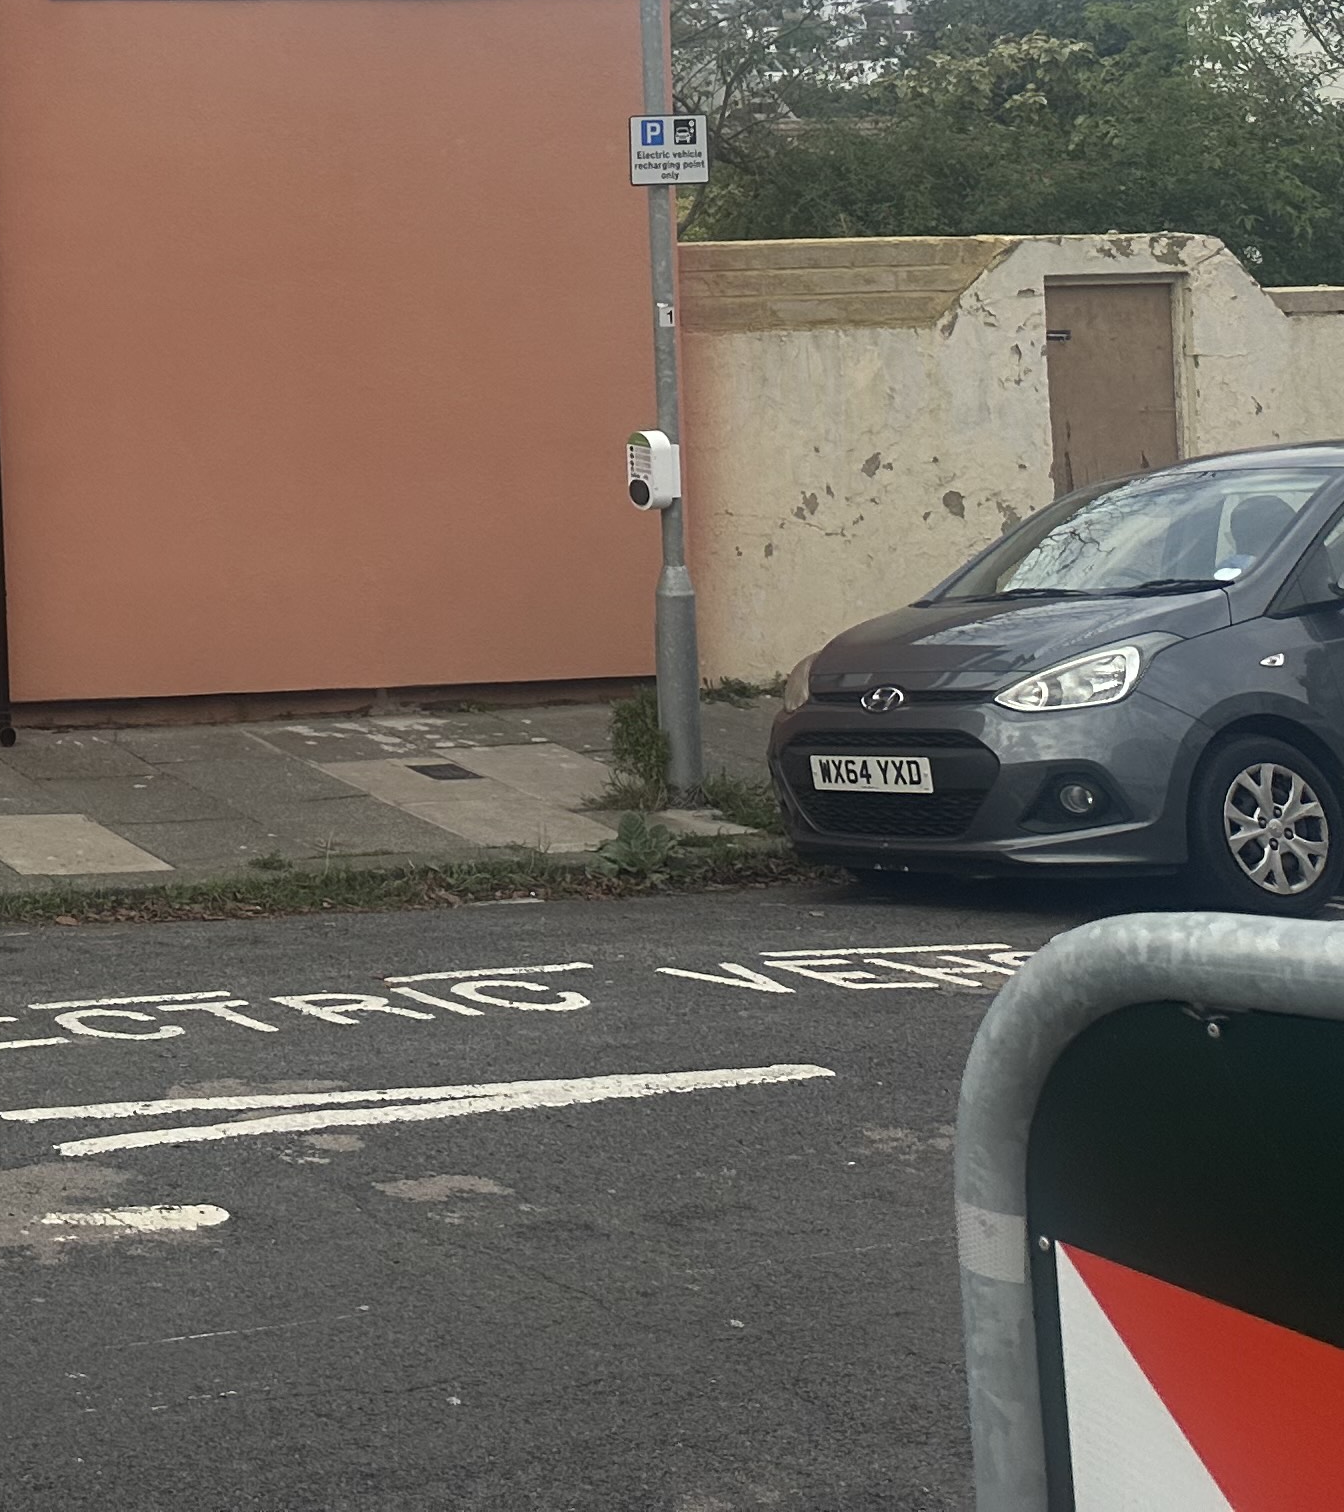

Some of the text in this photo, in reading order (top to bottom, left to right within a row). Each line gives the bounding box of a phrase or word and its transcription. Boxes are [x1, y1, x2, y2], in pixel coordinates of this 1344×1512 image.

[646, 122, 661, 144] P
[637, 149, 702, 160] Electric vehicle
[634, 160, 705, 171] recharging point
[661, 171, 679, 180] only
[818, 759, 922, 786] WX64 YXD
